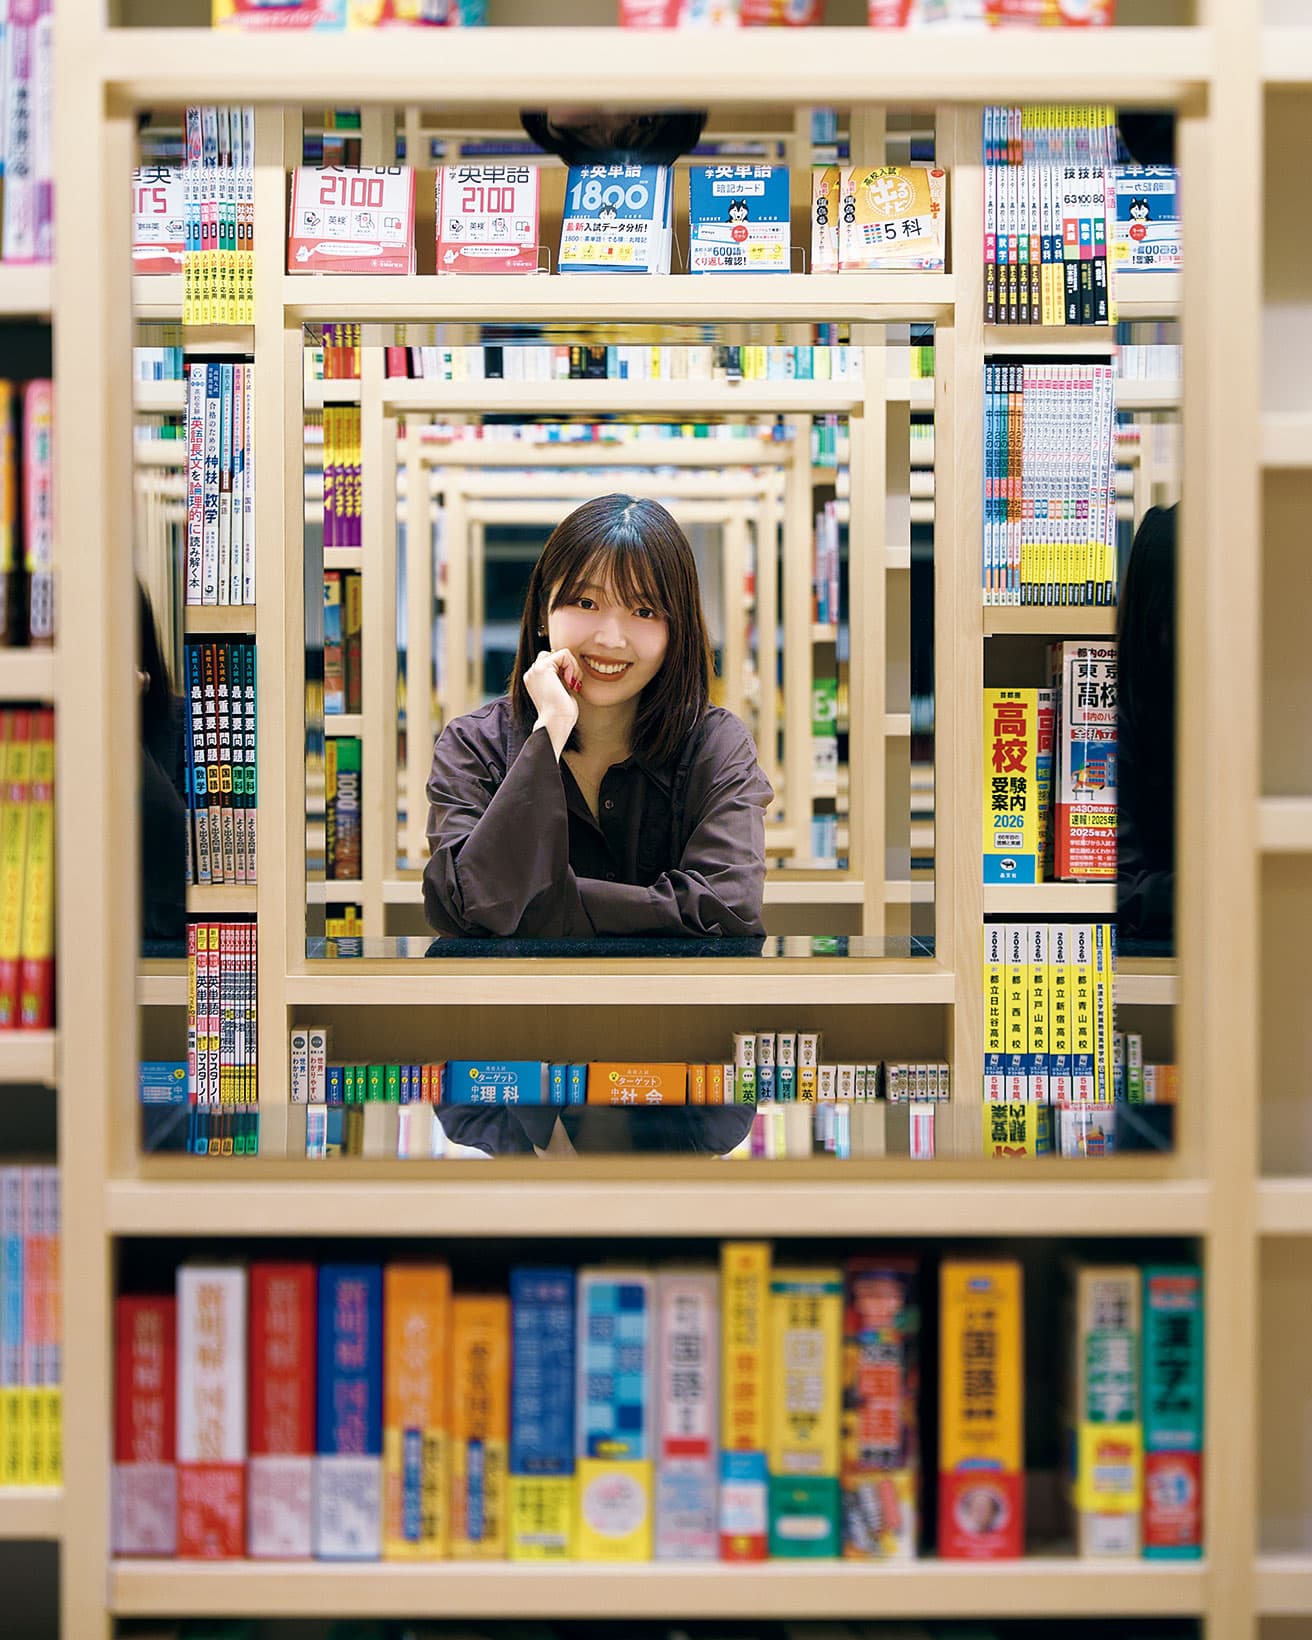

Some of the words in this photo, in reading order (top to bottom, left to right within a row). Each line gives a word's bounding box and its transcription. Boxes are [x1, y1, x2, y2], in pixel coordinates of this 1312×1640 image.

[458, 166, 530, 183] 英単語
[716, 183, 761, 193] 暗記カード
[320, 176, 384, 207] 2100
[462, 187, 515, 213] 2100
[570, 180, 649, 211] 1800
[1064, 194, 1077, 204] 63
[1078, 195, 1091, 204] 100
[1093, 194, 1104, 204] 80
[208, 401, 217, 453] 合格のための
[204, 454, 218, 485] 神技
[205, 493, 218, 524] 数学
[1078, 664, 1120, 680] 東京
[191, 686, 204, 762] 最重要問題
[205, 685, 217, 761] 最重要問題
[218, 685, 230, 761] 最重要問題
[232, 686, 243, 762] 最重要問題
[245, 686, 255, 762] 最重要問題
[992, 701, 1028, 774] 高校
[209, 768, 217, 790] 国語
[222, 768, 230, 790] 国語
[992, 777, 1027, 794] 受験
[991, 794, 1026, 811] 案内
[993, 814, 1025, 828] 2026
[1034, 930, 1042, 959] 2026
[196, 975, 208, 1016] 英単語
[209, 975, 220, 1016] 英単語
[990, 975, 1000, 1048] 都立日比谷高校
[1012, 975, 1022, 1048] 都立西高校
[1034, 975, 1044, 1048] 都立戸山高校
[1056, 976, 1066, 1049] 都立新宿高校
[1078, 975, 1088, 1048] 都立青山高校
[478, 1073, 514, 1082] ターゲット
[618, 1076, 657, 1086] ターゲット
[479, 1085, 519, 1104] 理科
[620, 1088, 663, 1104] 社会
